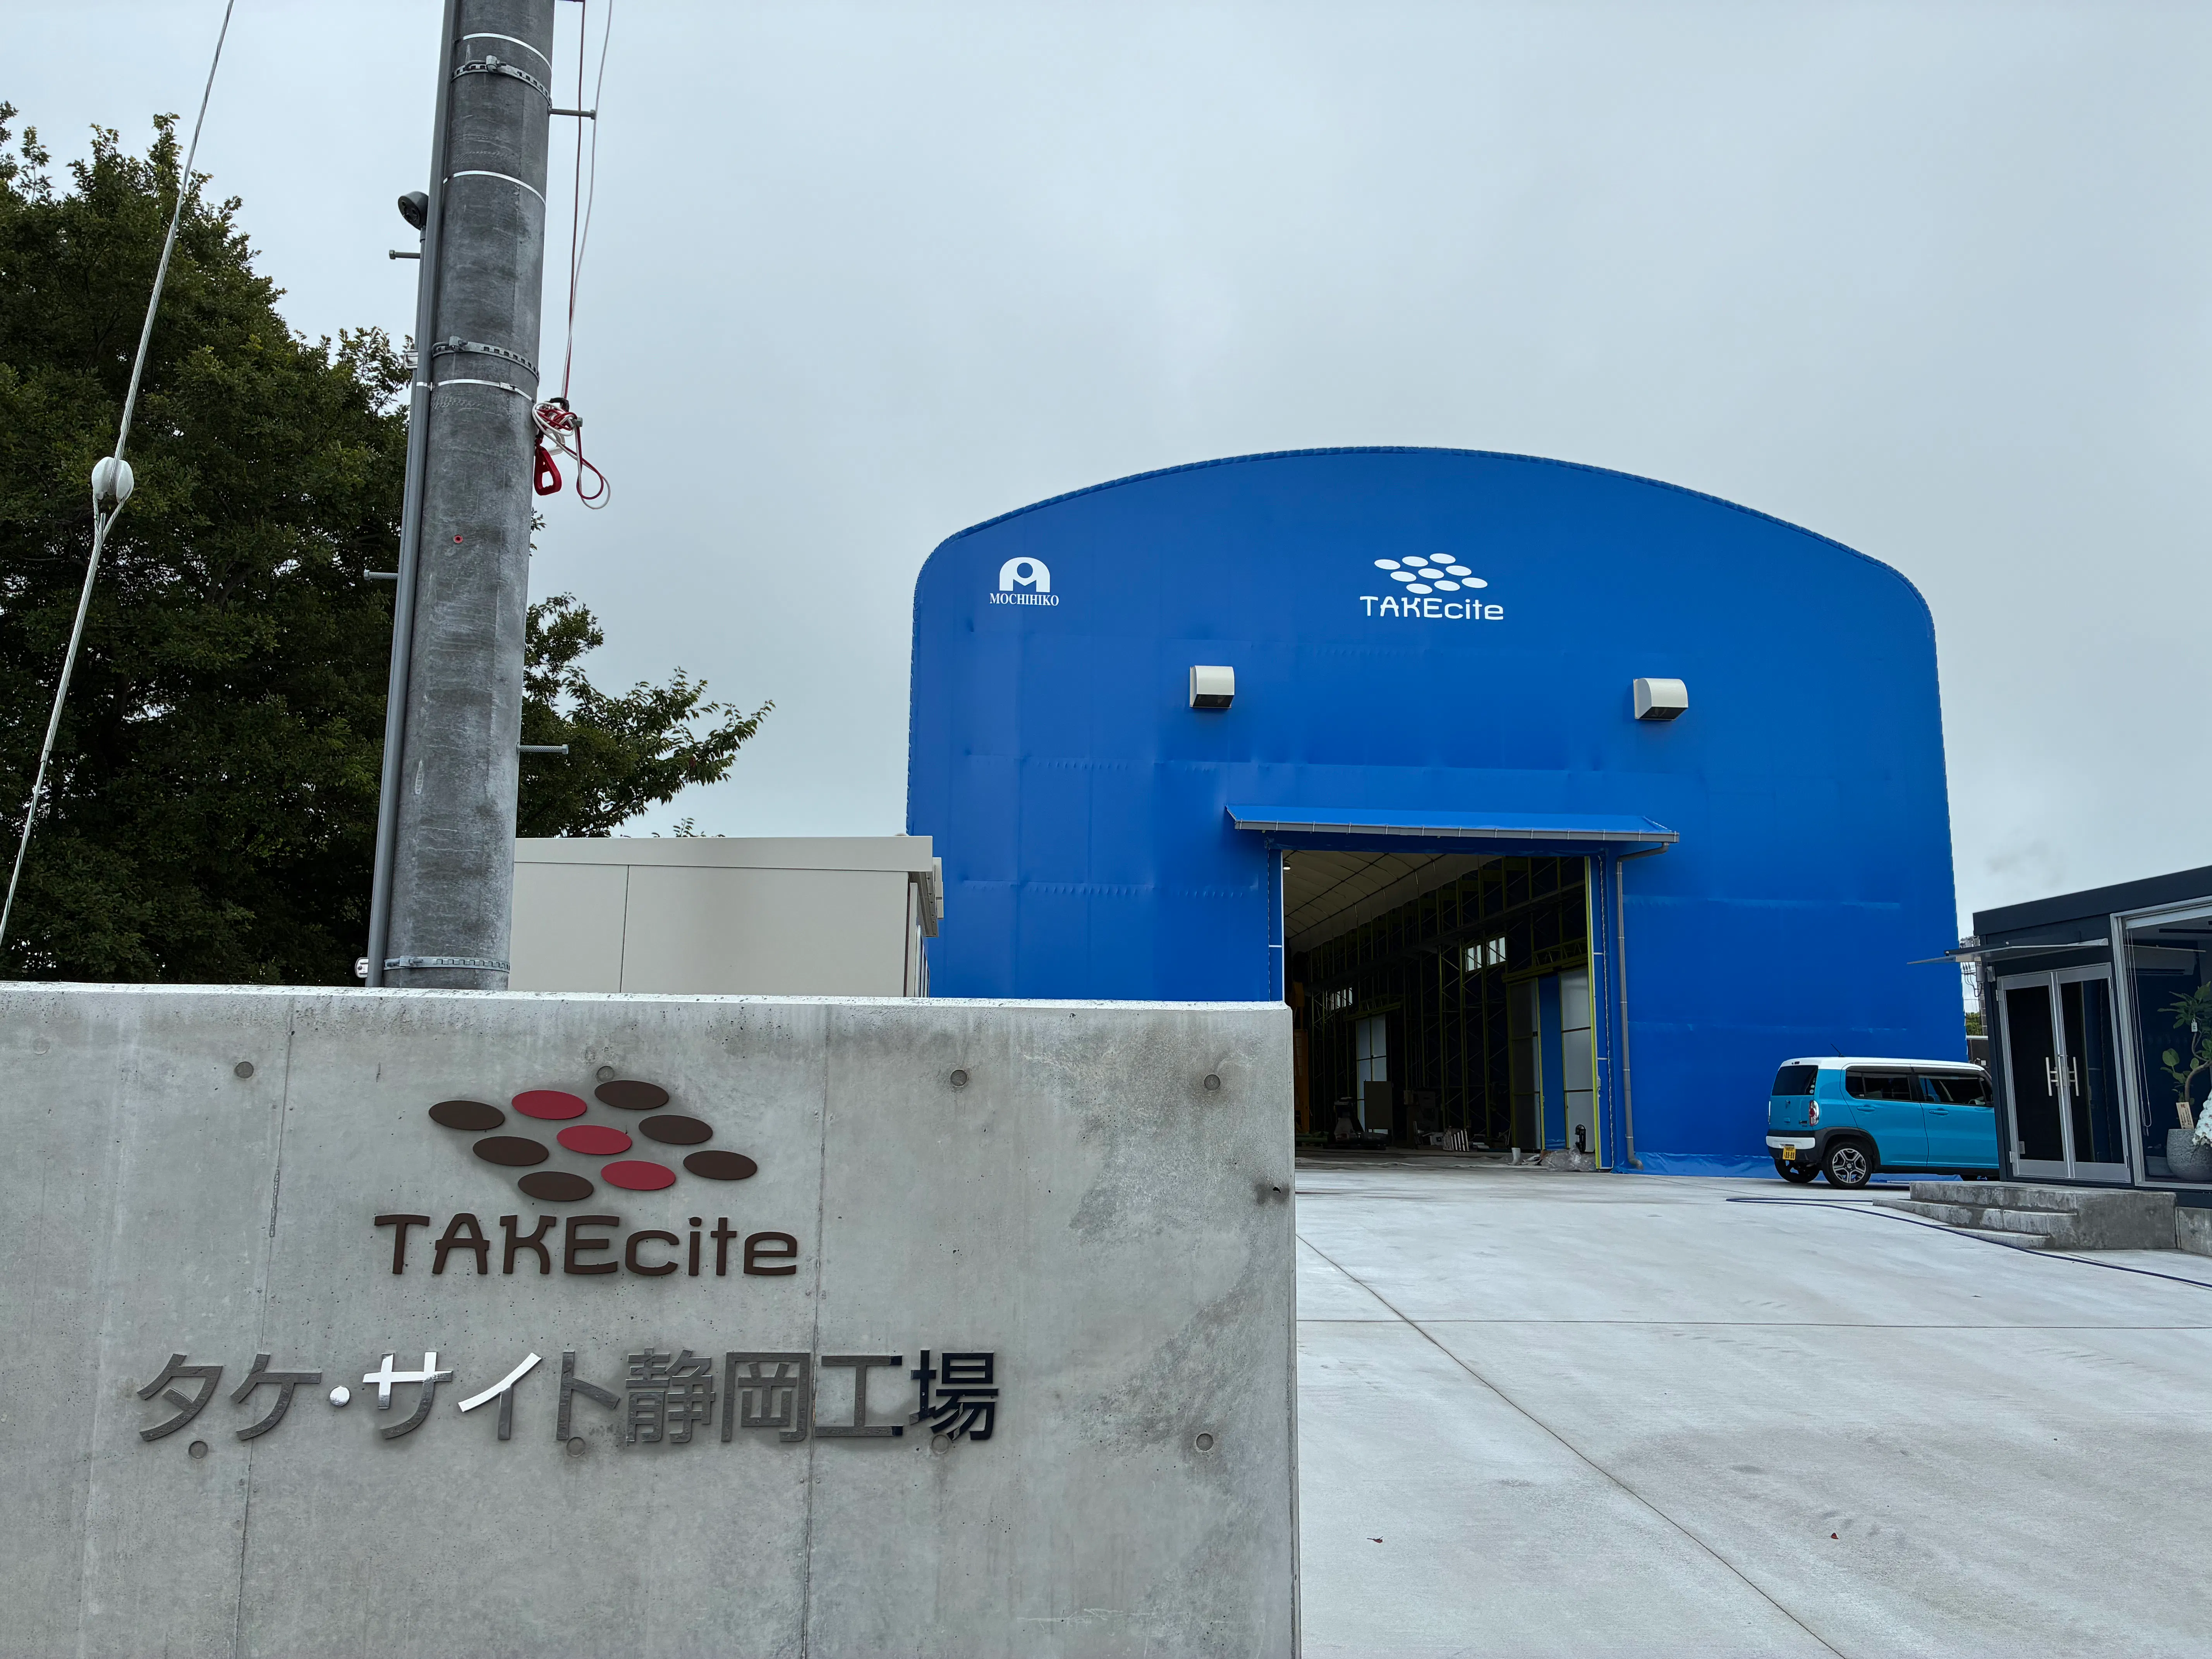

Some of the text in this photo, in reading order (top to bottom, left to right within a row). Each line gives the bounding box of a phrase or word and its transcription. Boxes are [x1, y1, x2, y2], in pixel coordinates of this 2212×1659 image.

[990, 593, 1059, 606] MOCHIHIKO
[1360, 596, 1504, 620] TAKEcite
[374, 1212, 798, 1276] TAKEcite
[137, 1349, 999, 1442] タケ・サイト静岡工場
